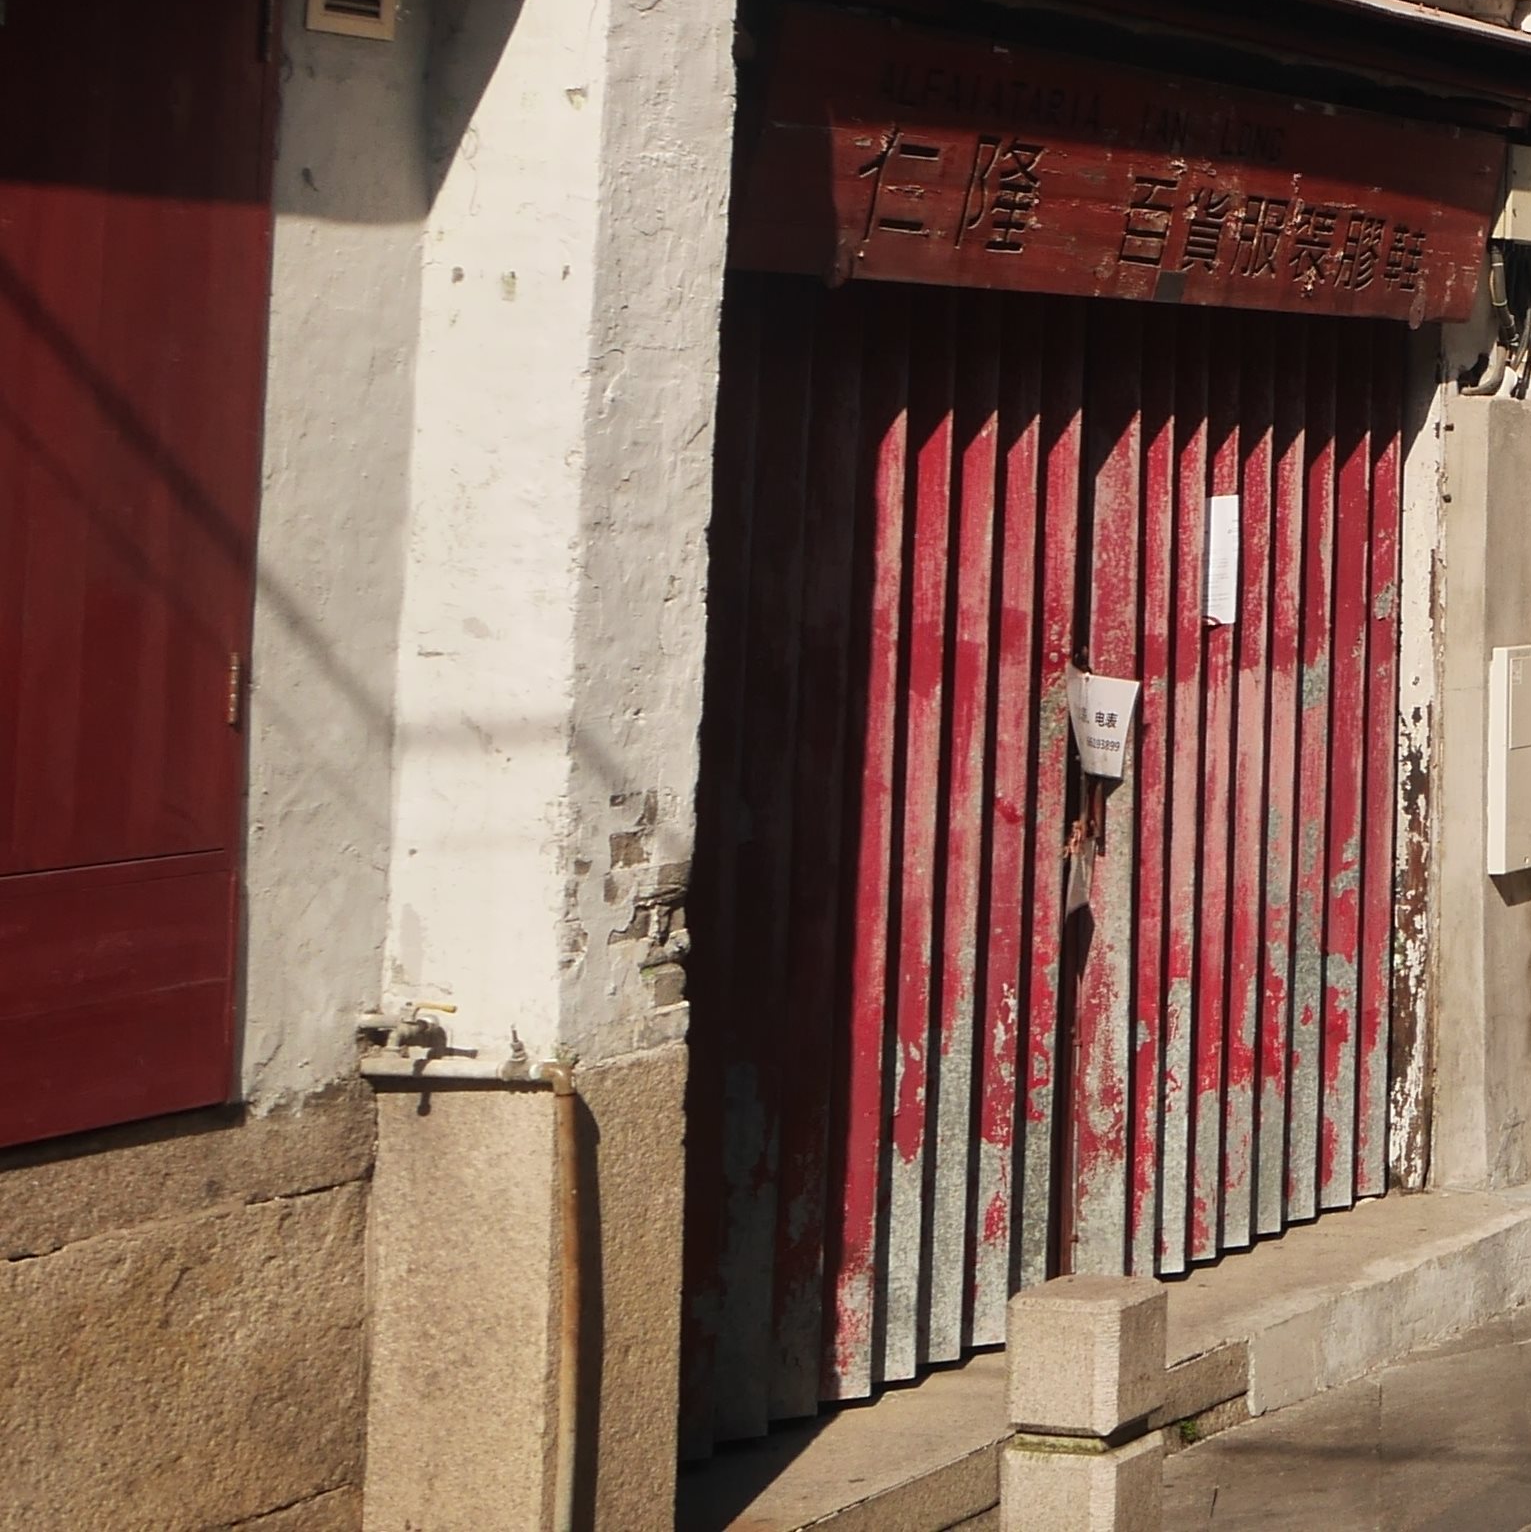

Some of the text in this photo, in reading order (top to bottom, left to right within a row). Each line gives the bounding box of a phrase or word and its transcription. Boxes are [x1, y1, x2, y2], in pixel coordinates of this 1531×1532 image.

[878, 61, 1101, 136] ALFAIATARIA
[1218, 121, 1288, 163] LONG
[858, 124, 1428, 293] 仁隆 百貨服裝膠鞋
